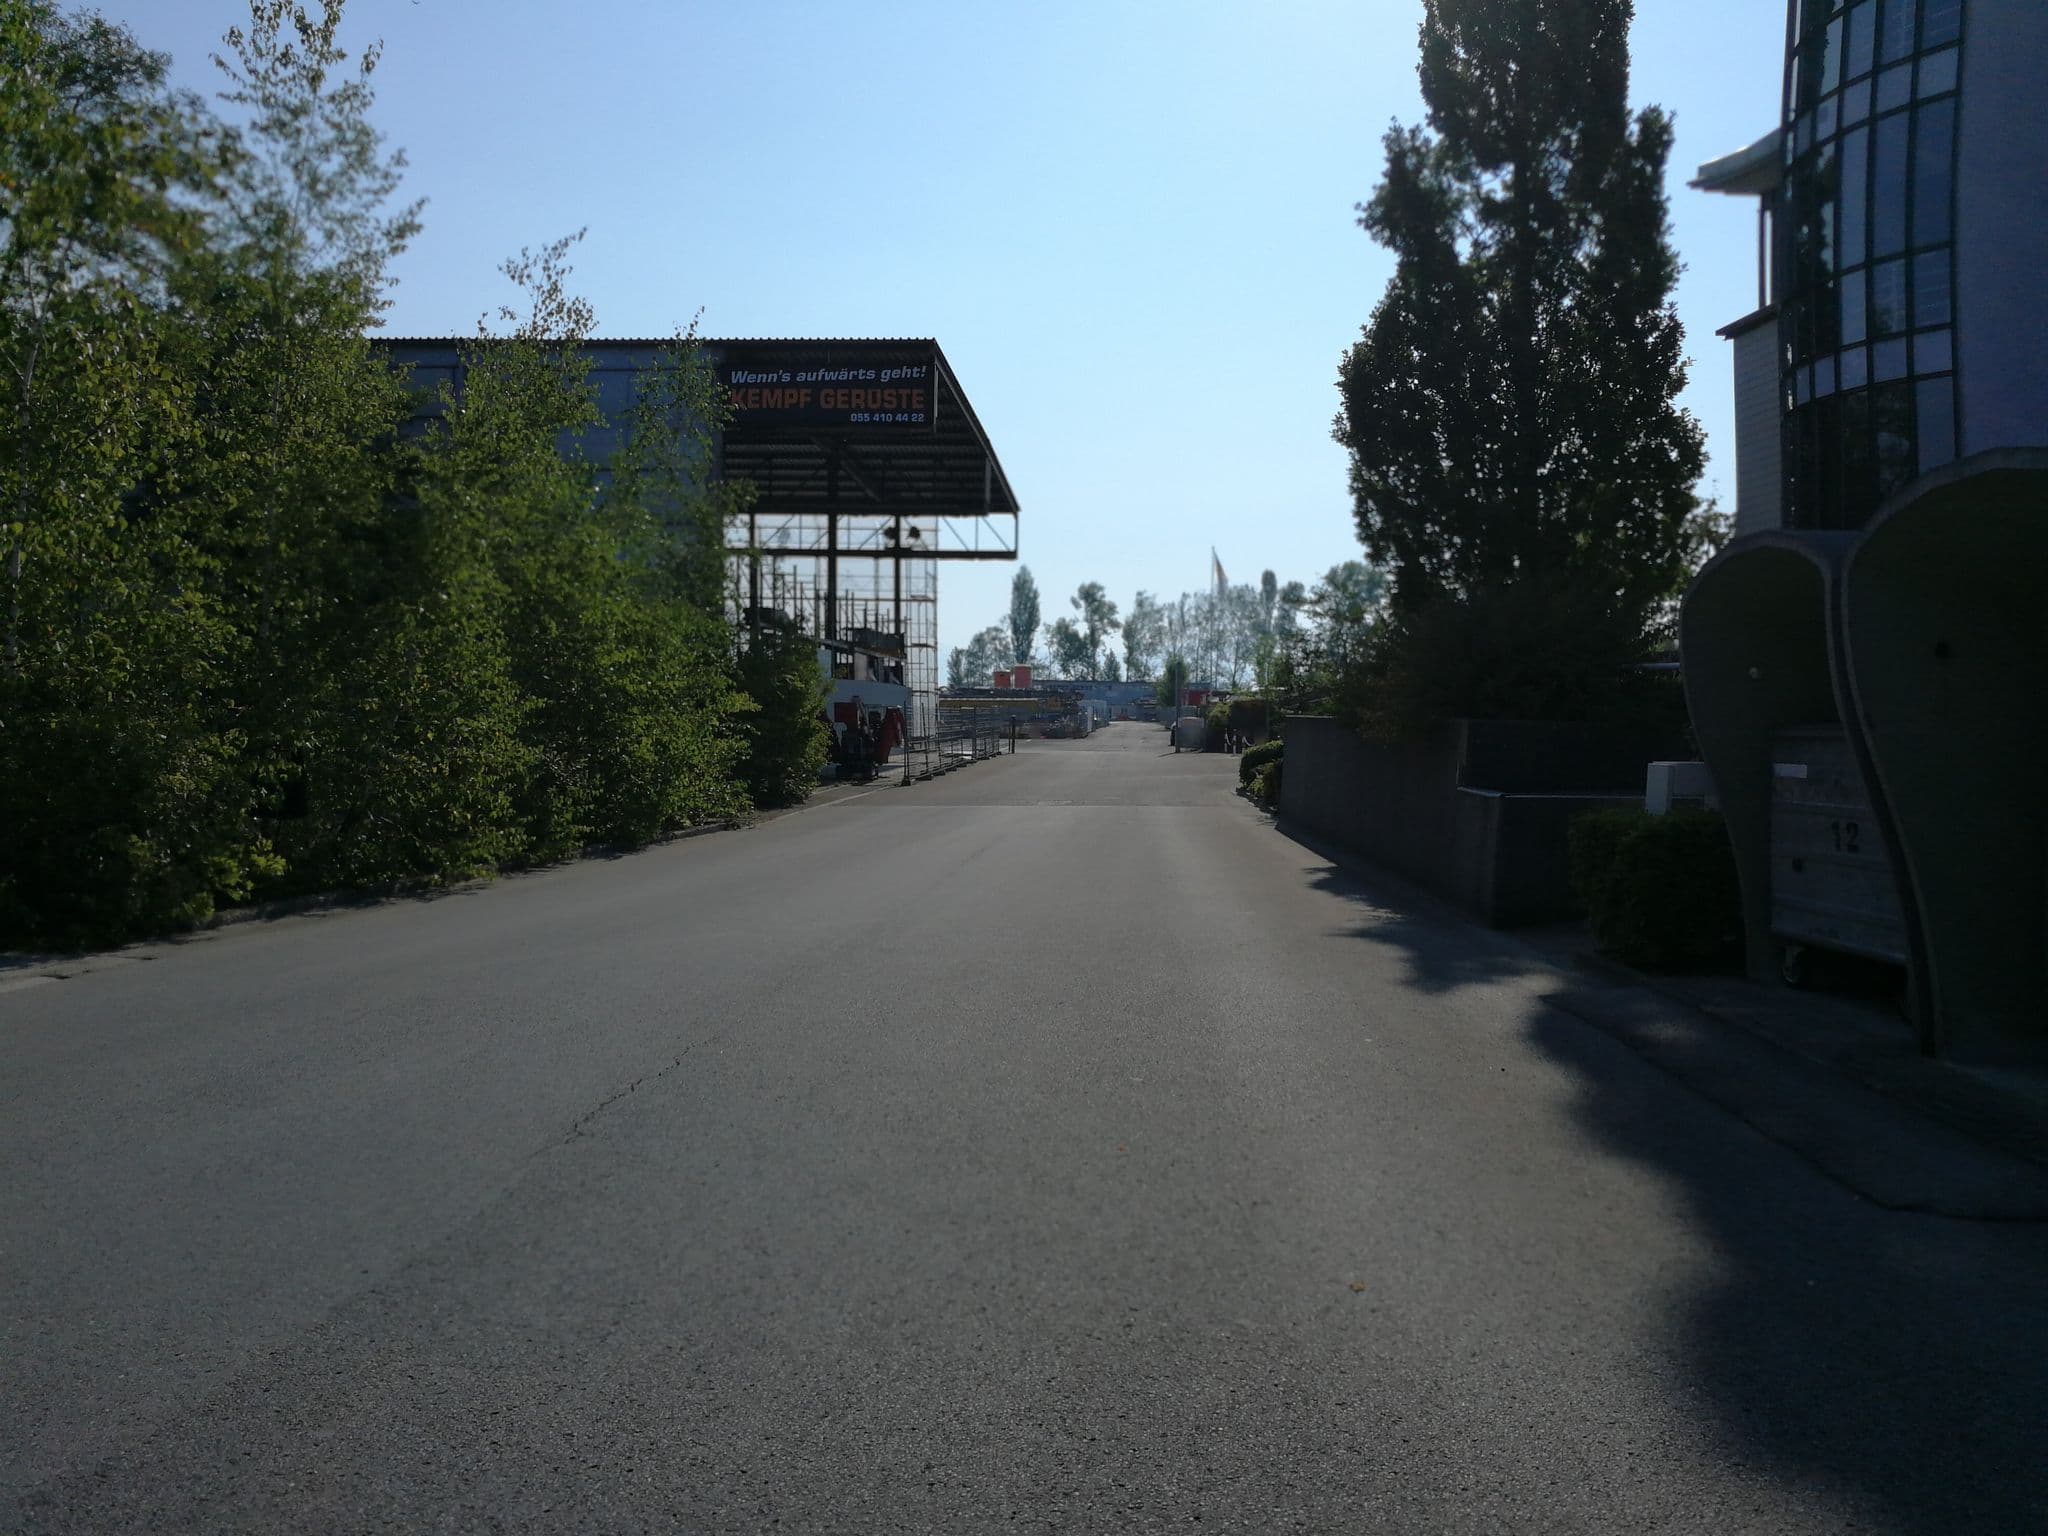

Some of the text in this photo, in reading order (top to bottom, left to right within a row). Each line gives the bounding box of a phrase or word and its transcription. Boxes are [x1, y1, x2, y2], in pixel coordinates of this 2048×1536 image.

[731, 365, 927, 383] Wenn's aufwärts geht!
[730, 388, 812, 409] KEMPF
[850, 413, 925, 422] 055 410 44 22
[1832, 822, 1859, 852] 12
